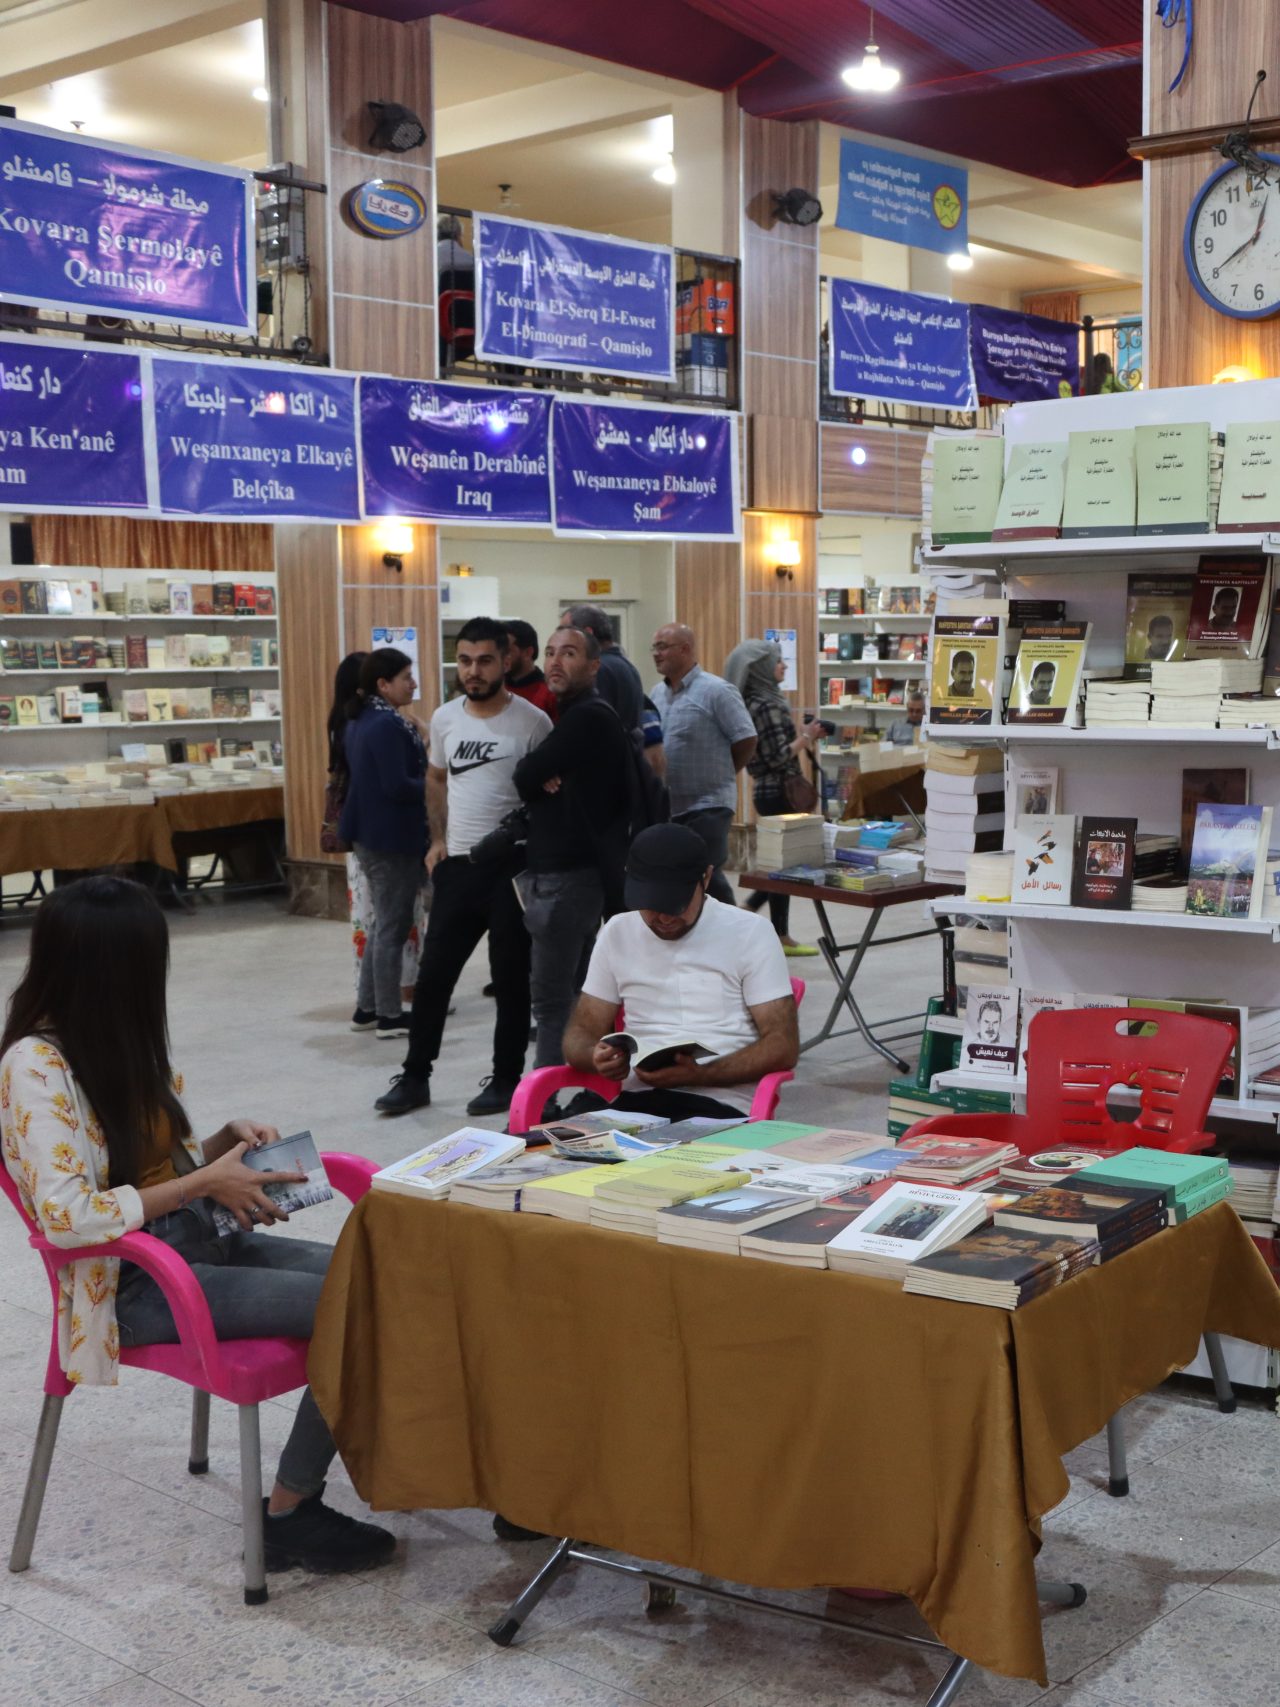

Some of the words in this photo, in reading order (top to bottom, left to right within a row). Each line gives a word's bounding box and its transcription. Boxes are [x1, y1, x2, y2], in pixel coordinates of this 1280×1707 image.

[2, 155, 74, 188] قامشلو
[169, 190, 209, 216] مجلة
[1225, 185, 1240, 203] 11
[1210, 209, 1227, 227] 10
[0, 207, 90, 244] Kovara
[97, 227, 223, 269] Şermolayê
[1204, 237, 1214, 254] 9
[64, 259, 168, 295] Qamişlo
[1212, 267, 1220, 279] 8
[1231, 284, 1239, 297] 7
[1254, 284, 1264, 301] 6
[496, 291, 544, 312] Kovara
[550, 299, 598, 324] El-Şerq
[601, 308, 656, 329] El-Ewset
[601, 337, 653, 358] Qamişlo
[39, 368, 61, 399] دار
[183, 384, 226, 416] بلجيكا
[318, 393, 338, 423] دار
[597, 424, 631, 450] دمشق
[171, 436, 291, 464] Weşanxaneya
[297, 445, 354, 471] Elkayê
[390, 446, 467, 473] Weşanên
[473, 451, 547, 475] Derabînê
[232, 478, 295, 504] Belçîka
[572, 469, 660, 493] Weşanxaneya
[663, 473, 717, 498] Ebkaloyê
[456, 486, 493, 512] Iraq
[633, 503, 661, 523] Şam
[453, 741, 499, 760] NIKE
[994, 1050, 1008, 1058] كيف
